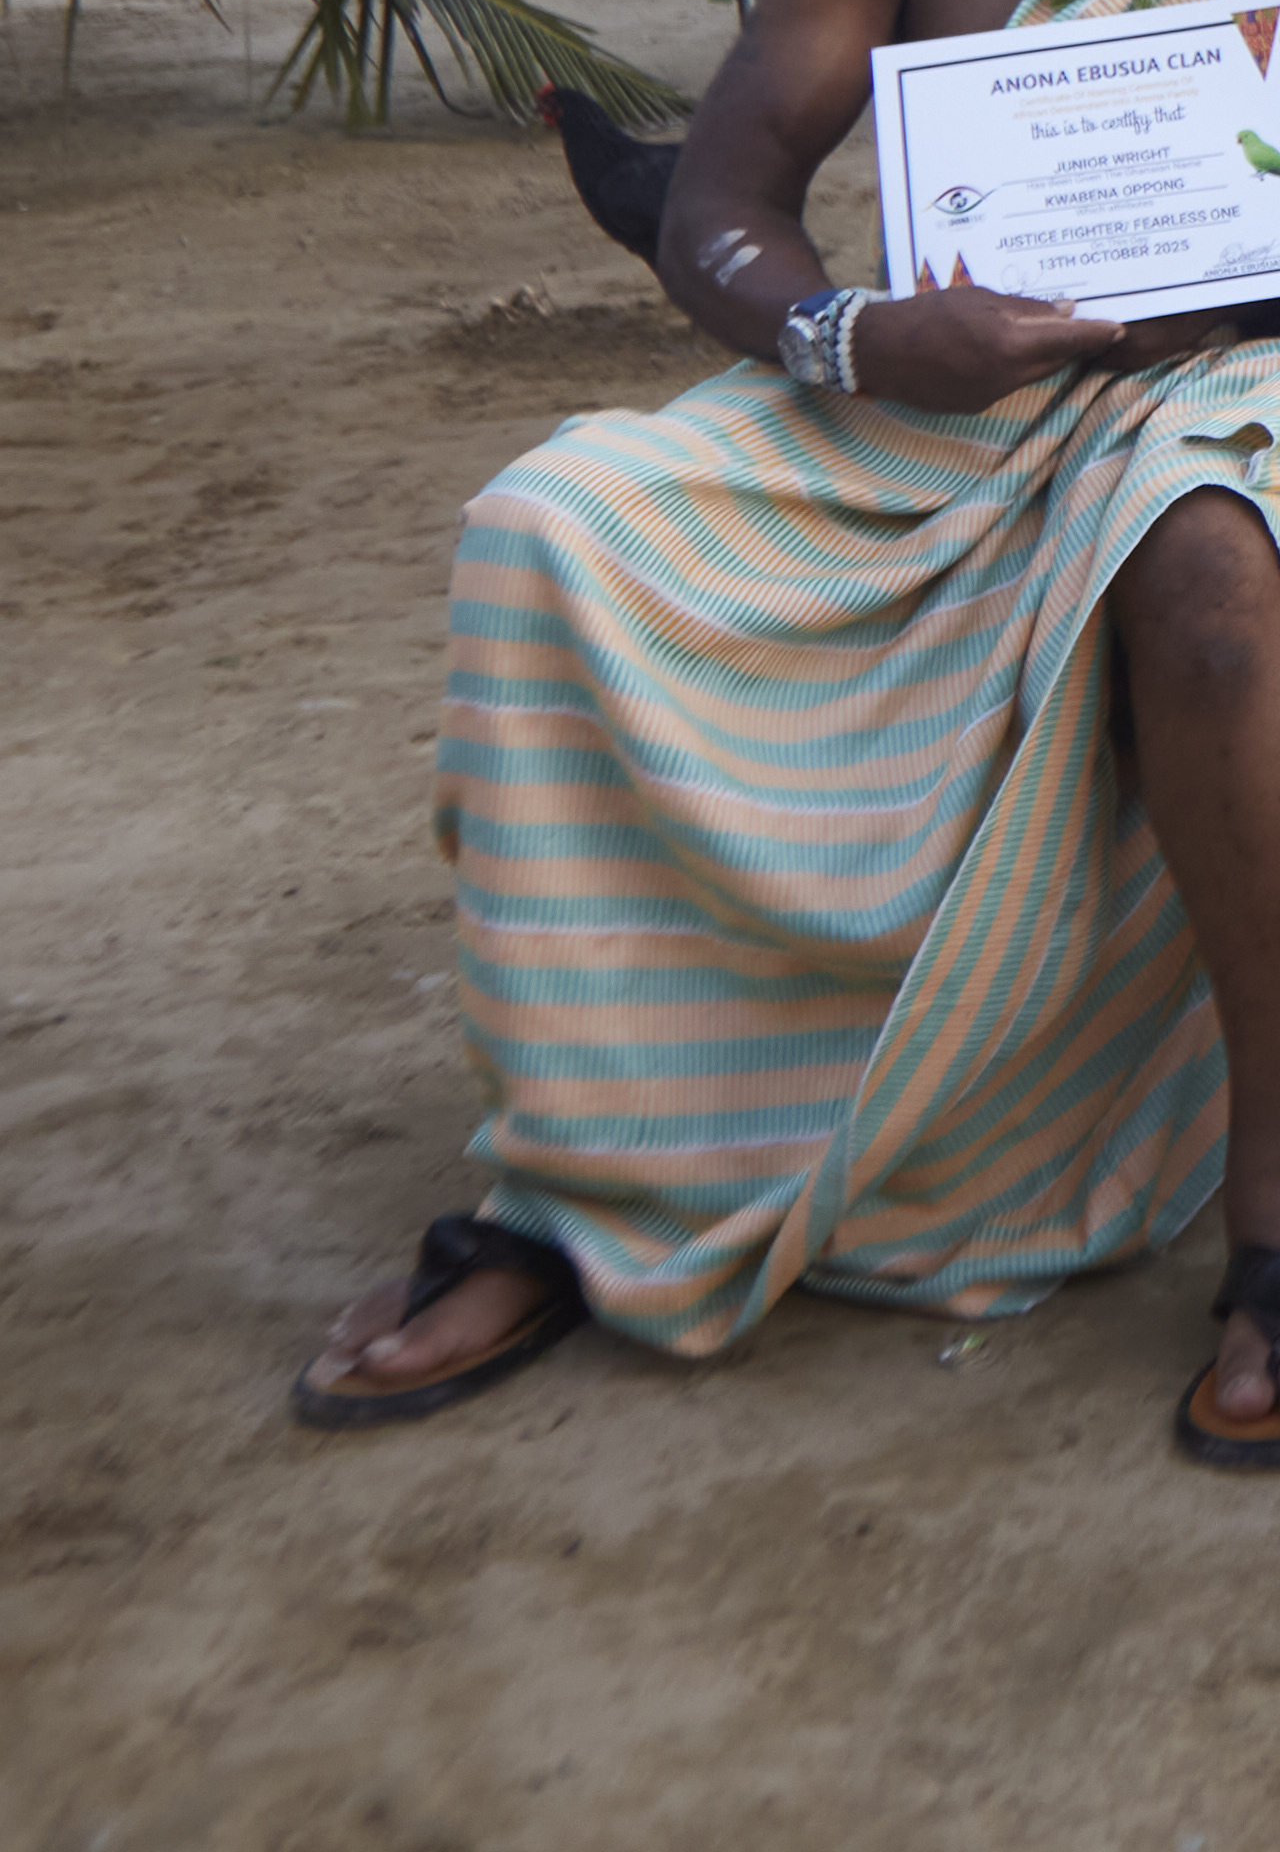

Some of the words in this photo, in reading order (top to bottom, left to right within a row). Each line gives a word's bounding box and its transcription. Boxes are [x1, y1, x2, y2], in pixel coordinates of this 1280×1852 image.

[990, 70, 1070, 95] ANONA
[1077, 57, 1160, 83] EBUSUA
[1166, 48, 1222, 70] CLAN
[1030, 120, 1061, 140] this
[1063, 121, 1078, 136] is
[1081, 116, 1098, 134] to
[1101, 110, 1153, 135] certify
[1154, 103, 1187, 124] that
[1054, 154, 1108, 174] JUNIOR
[1113, 146, 1170, 165] WRIGHT
[1044, 188, 1118, 207] KWABENA
[1123, 177, 1185, 196] OPPONG
[996, 230, 1057, 250] JUSTICE
[1133, 211, 1207, 229] FEARLESS
[1210, 204, 1240, 221] ONE
[1039, 254, 1076, 271] 13TH
[1079, 246, 1150, 266] OCTOBER
[1154, 239, 1190, 255] 2025
